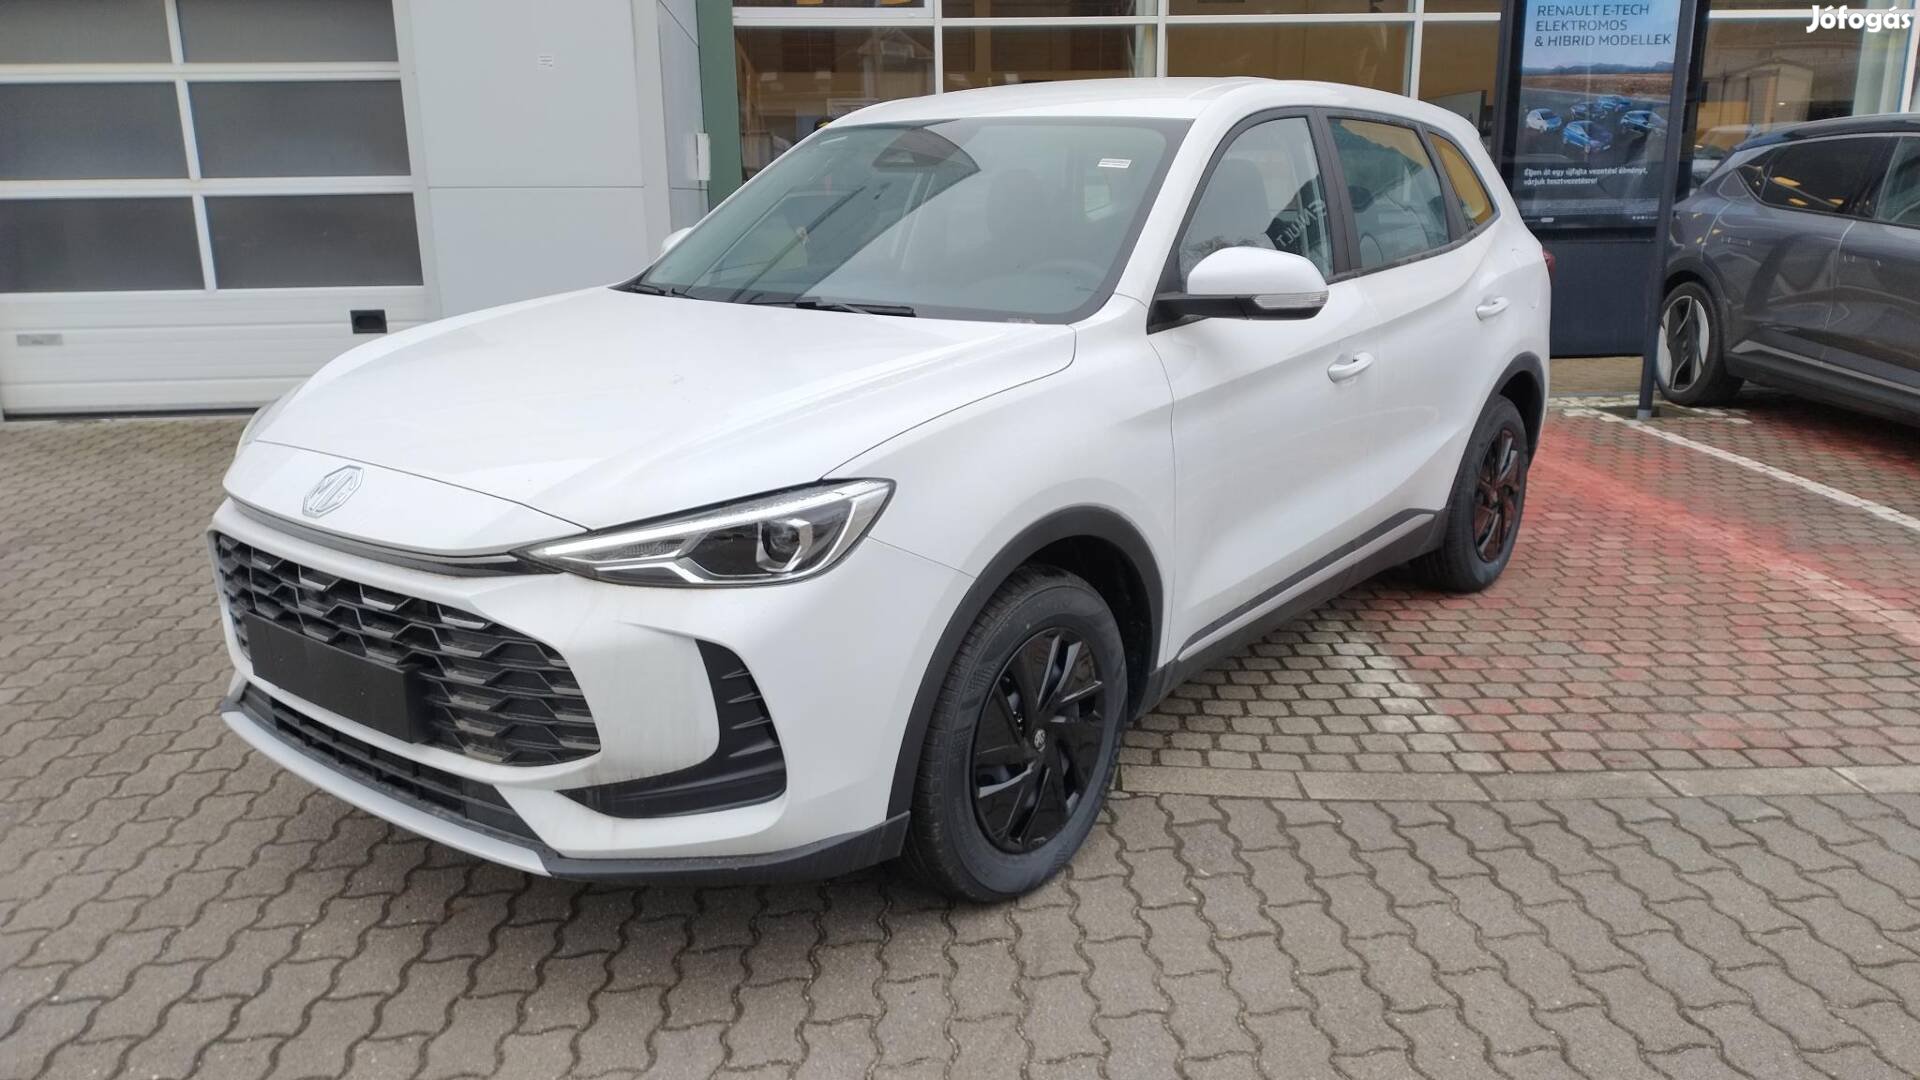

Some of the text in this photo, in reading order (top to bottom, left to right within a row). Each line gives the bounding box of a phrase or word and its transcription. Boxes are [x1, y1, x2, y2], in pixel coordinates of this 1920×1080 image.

[1537, 4, 1650, 16] RENAULT E-TECH
[1535, 19, 1628, 32] ELEKTROMOS
[1534, 33, 1672, 47] & HIBRID MODELLEK
[1552, 169, 1564, 177] egy
[305, 467, 360, 514] MG
